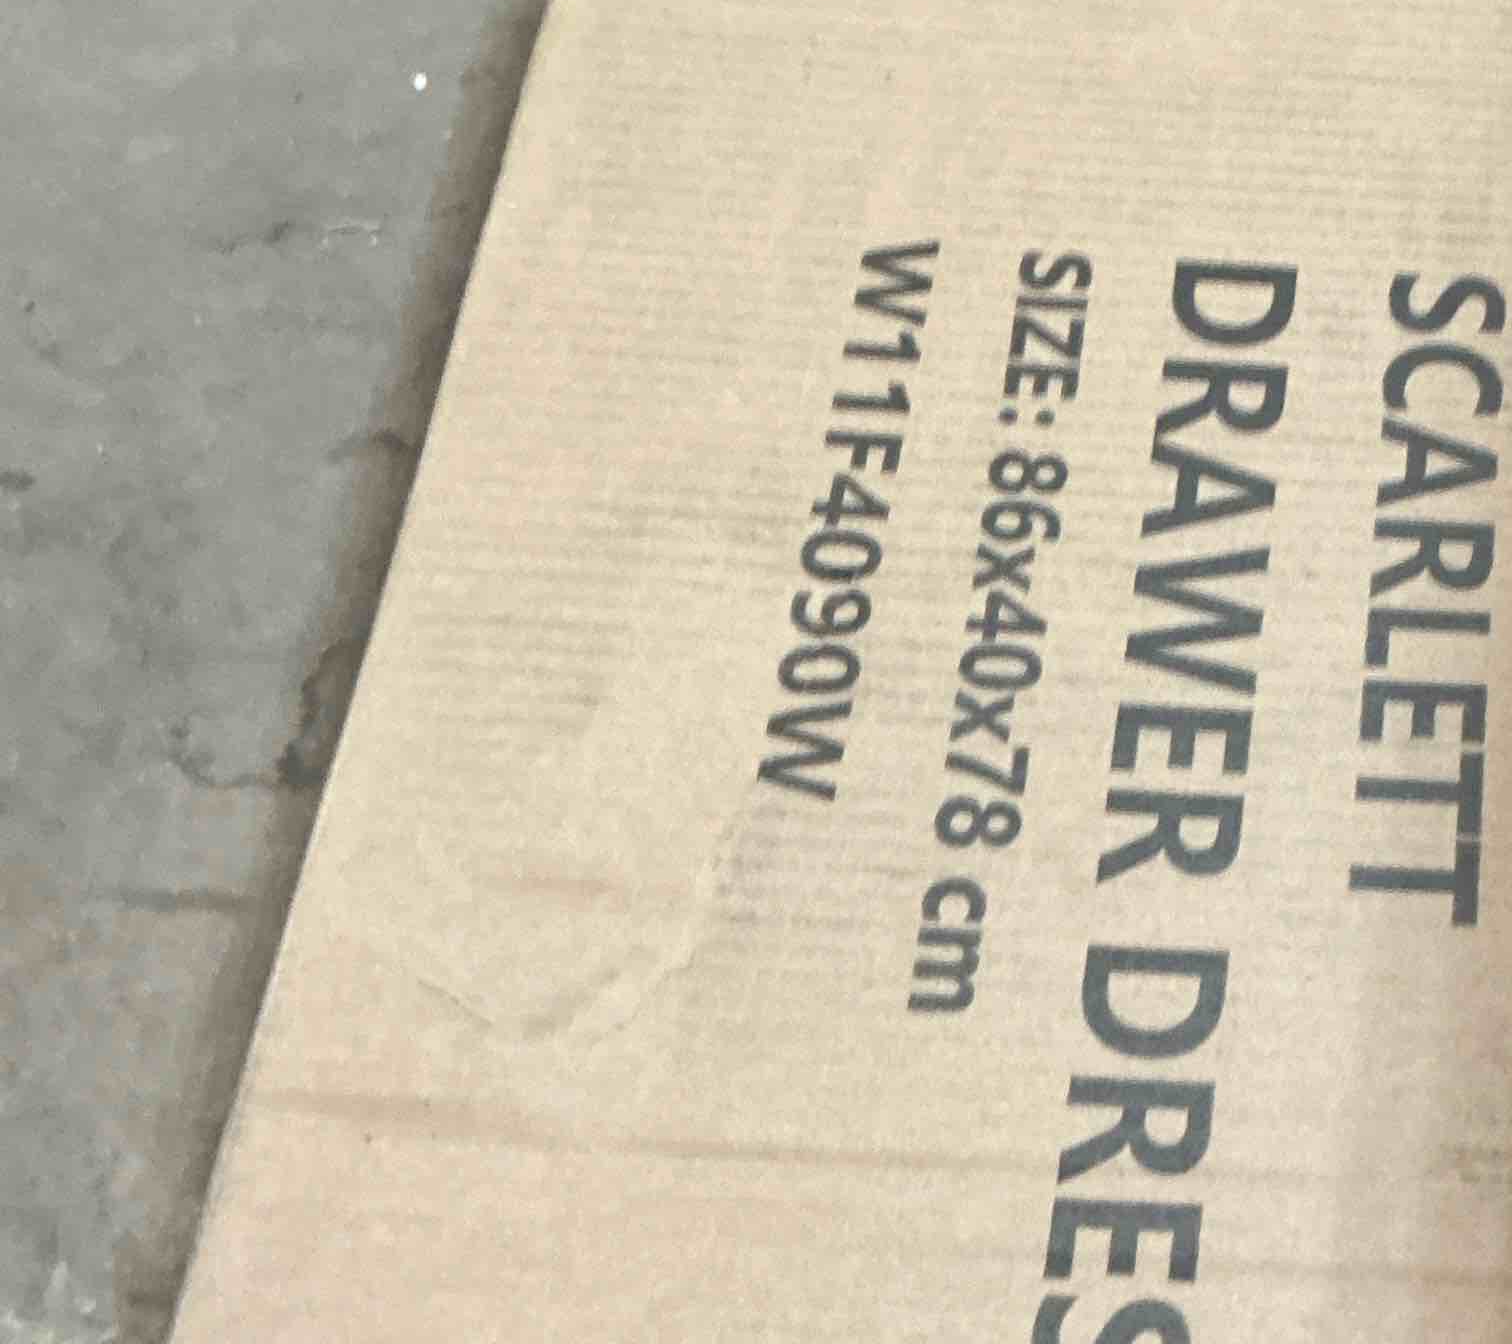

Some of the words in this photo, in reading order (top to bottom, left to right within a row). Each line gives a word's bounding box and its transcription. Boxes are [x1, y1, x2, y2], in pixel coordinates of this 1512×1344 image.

[757, 239, 941, 802] W11F4090W
[998, 250, 1093, 428] SIZE:
[1096, 259, 1299, 886] DRAWER
[933, 451, 1069, 851] 86x40x78
[1347, 271, 1508, 928] SCARLETT
[907, 876, 988, 1014] cm
